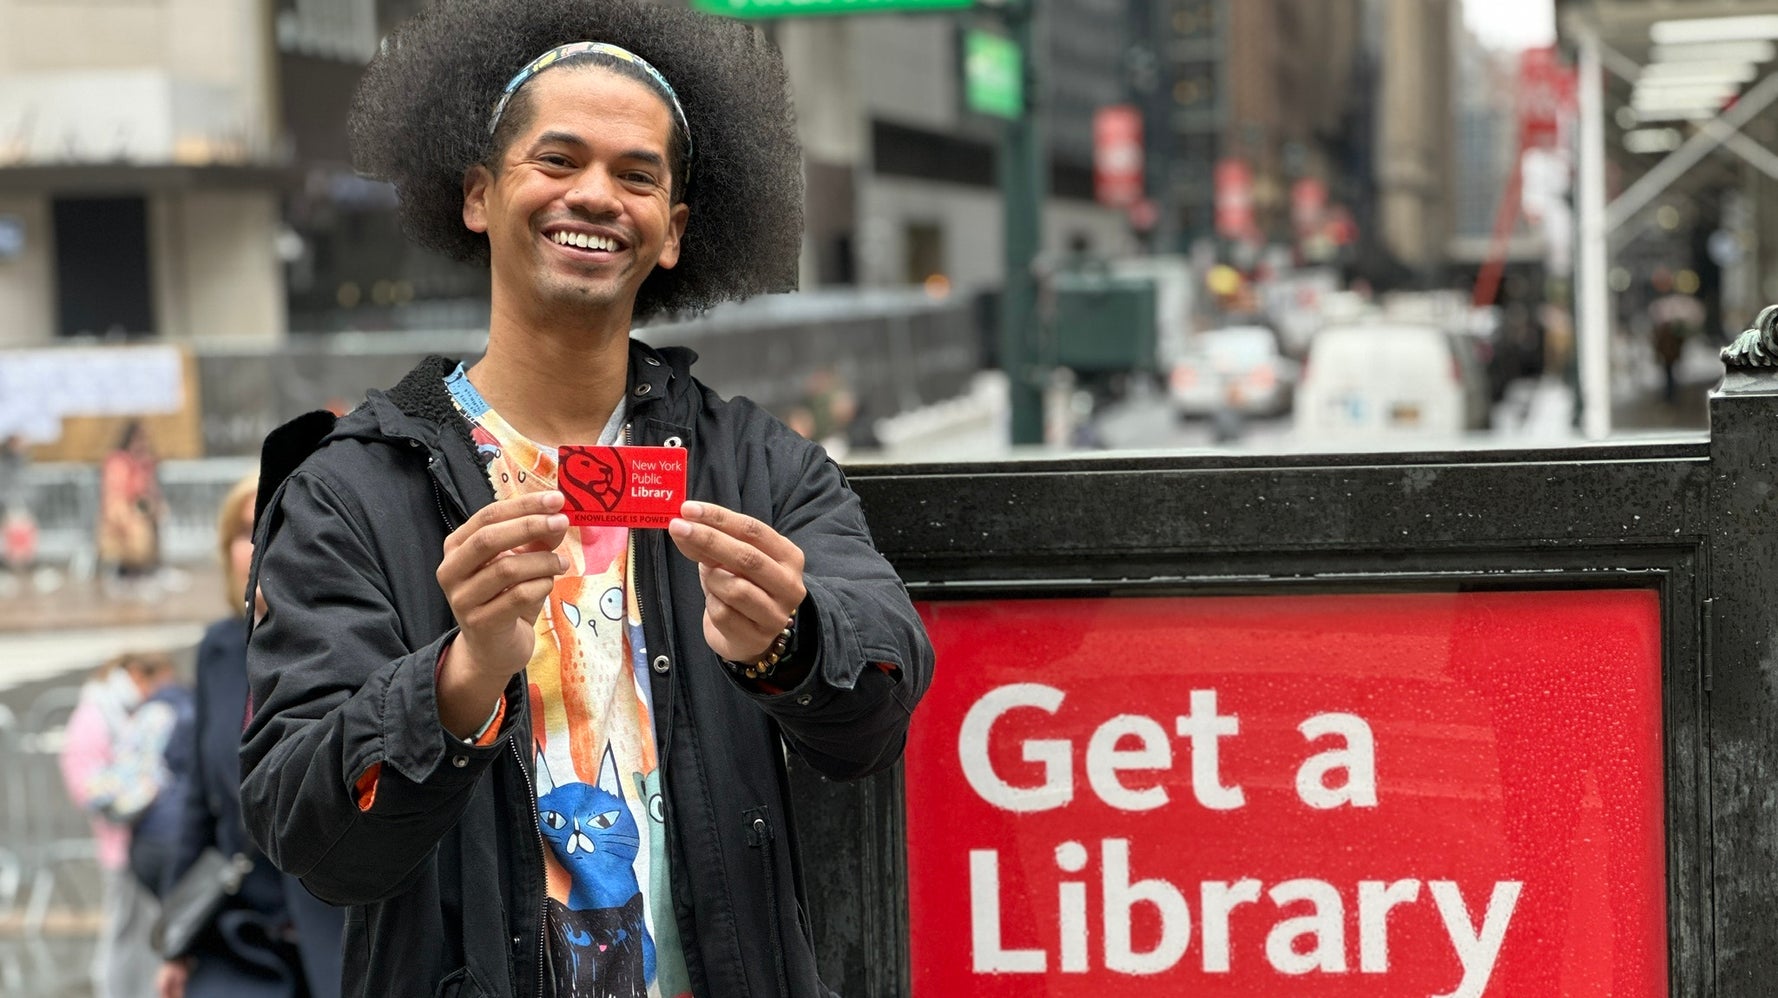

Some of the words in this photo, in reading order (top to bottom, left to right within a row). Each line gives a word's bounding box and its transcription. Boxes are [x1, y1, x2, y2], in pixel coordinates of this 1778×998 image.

[631, 460, 656, 471] New
[658, 460, 682, 471] York
[631, 473, 662, 485] Public
[631, 487, 673, 501] Library
[574, 514, 628, 523] KNOWLEDGE
[630, 515, 638, 523] IS
[639, 515, 669, 524] POWER
[958, 682, 1246, 812] Get
[1295, 711, 1378, 809] a
[968, 838, 1524, 998] Library
